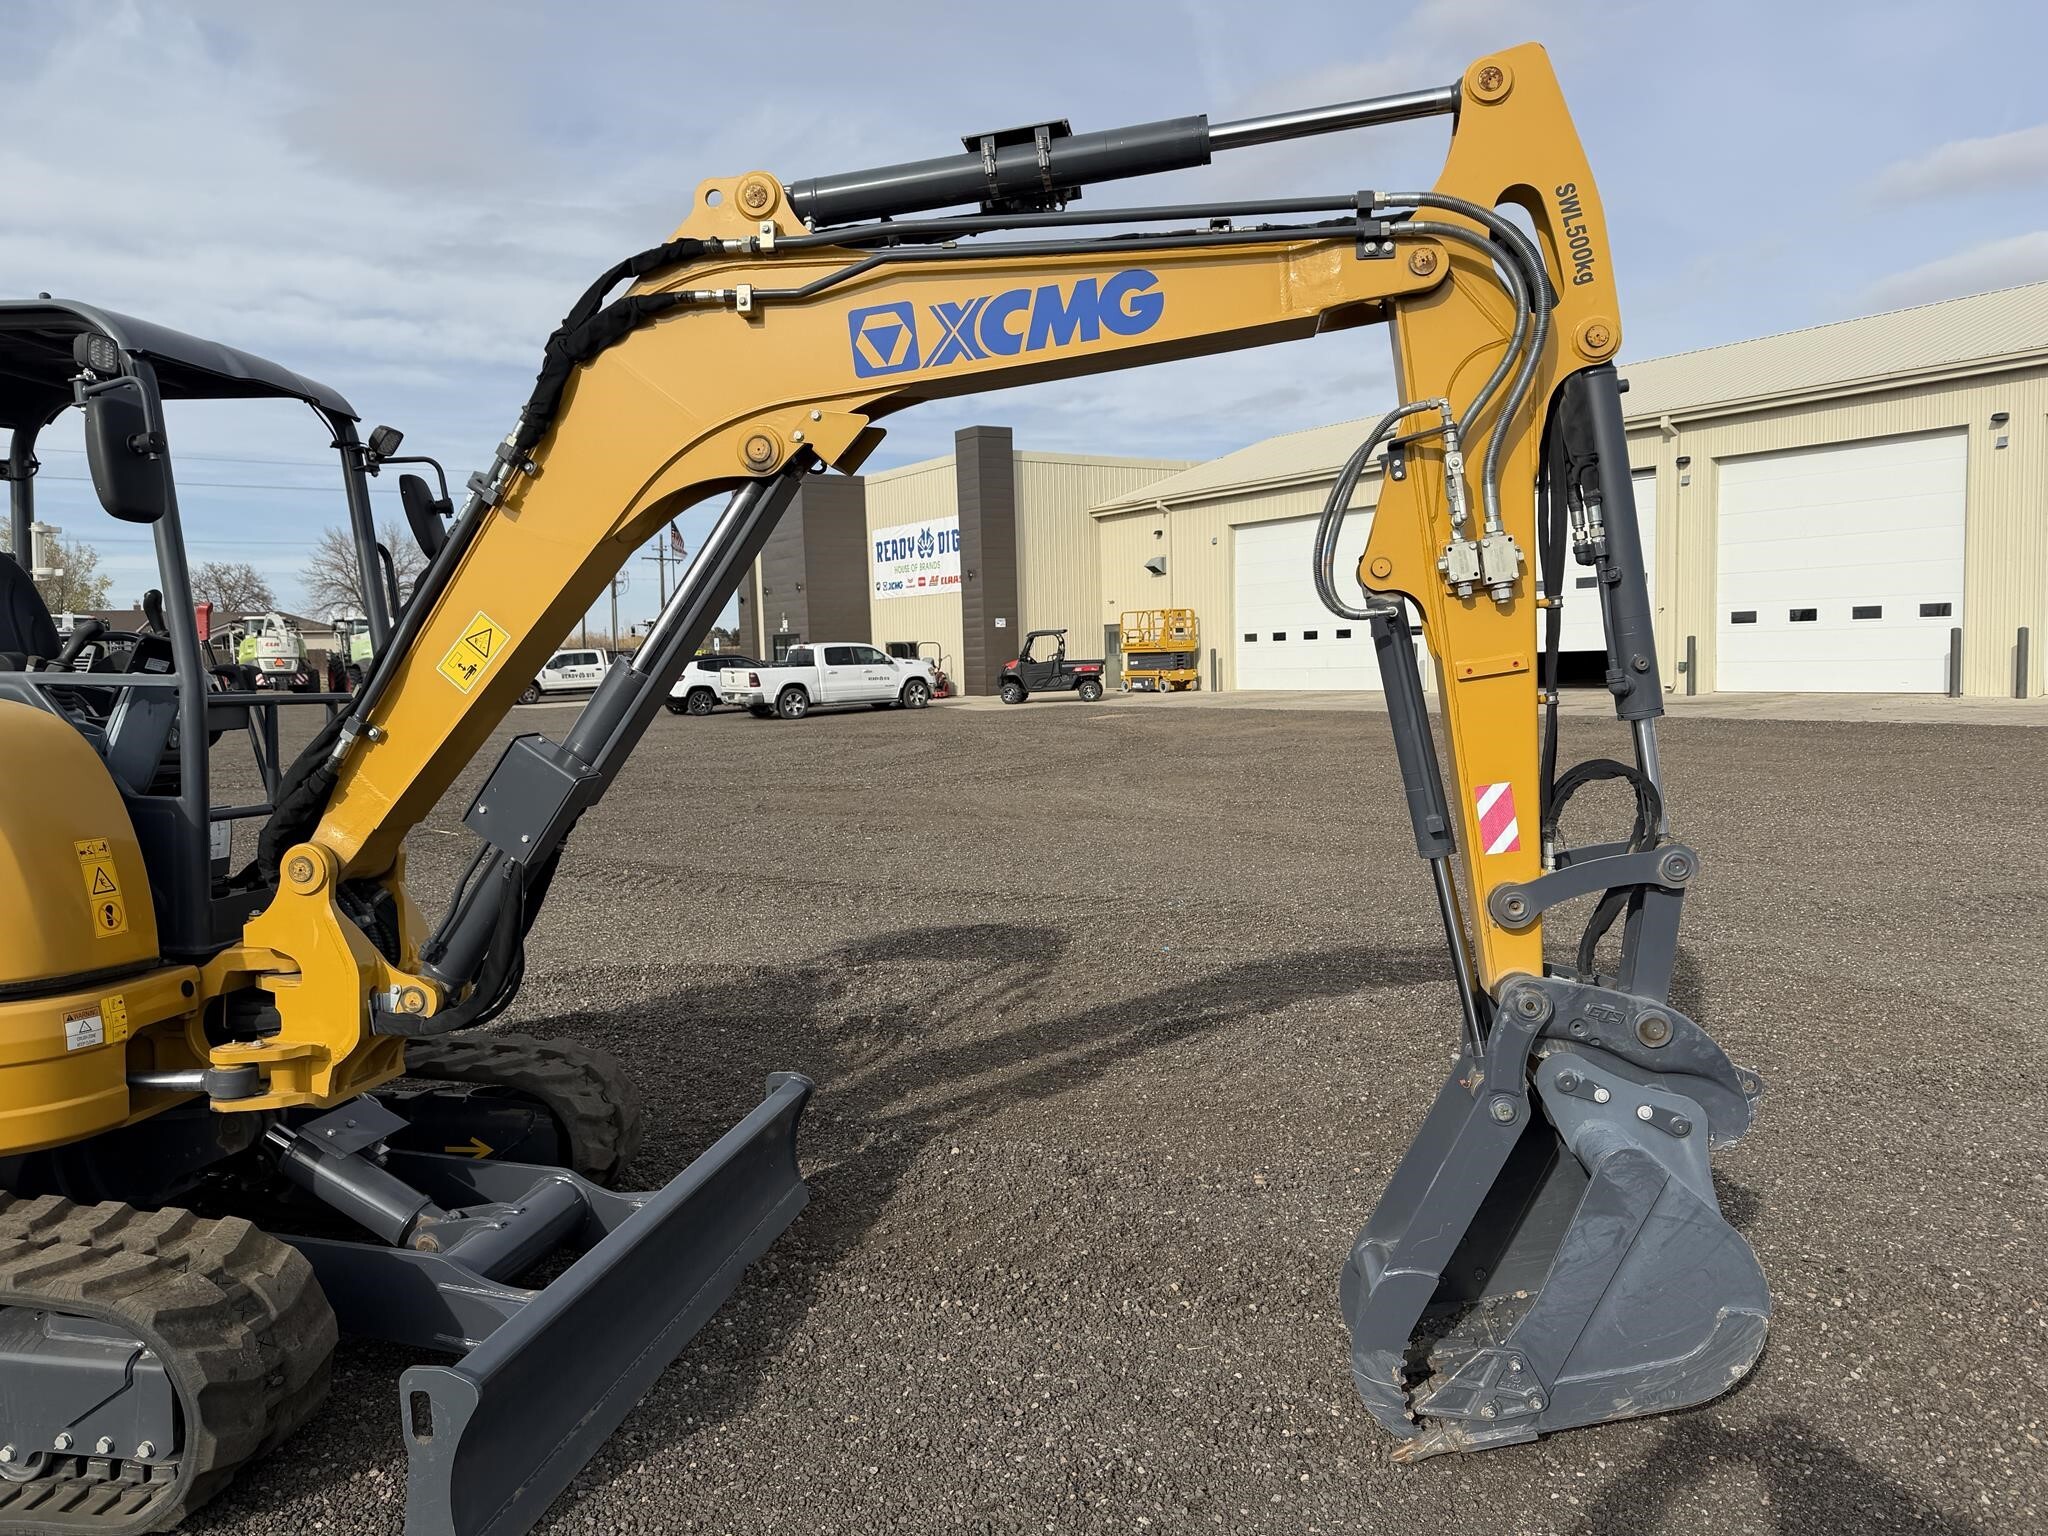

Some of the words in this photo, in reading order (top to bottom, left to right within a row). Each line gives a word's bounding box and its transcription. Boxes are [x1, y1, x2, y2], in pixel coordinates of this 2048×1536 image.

[1555, 182, 1594, 286] SWL500kg
[921, 269, 1164, 369] XCMG
[876, 536, 915, 563] READY
[938, 529, 960, 554] DIG
[894, 564, 910, 574] HOUSE
[911, 563, 918, 572] OF
[919, 560, 941, 571] BRANDS
